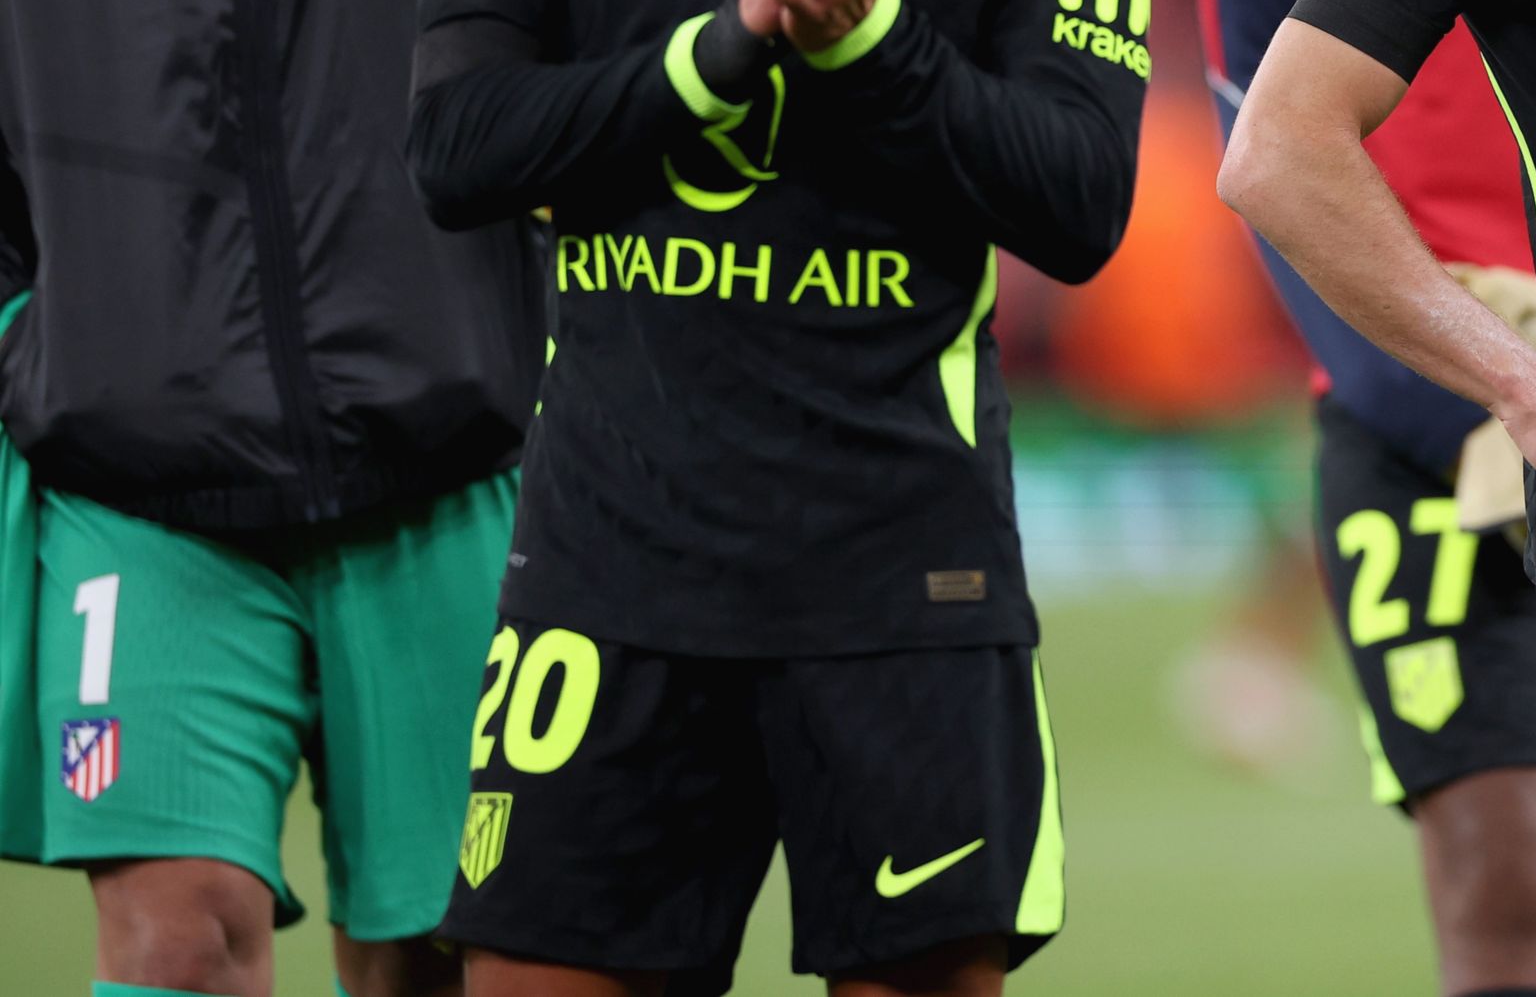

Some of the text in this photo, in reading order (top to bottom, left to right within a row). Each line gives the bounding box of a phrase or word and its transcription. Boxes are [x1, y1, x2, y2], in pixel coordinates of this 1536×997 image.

[1052, 12, 1152, 82] krake
[557, 233, 915, 308] RIYADH AIR
[1336, 497, 1479, 647] 27
[73, 573, 119, 705] 1
[469, 626, 601, 774] 20
